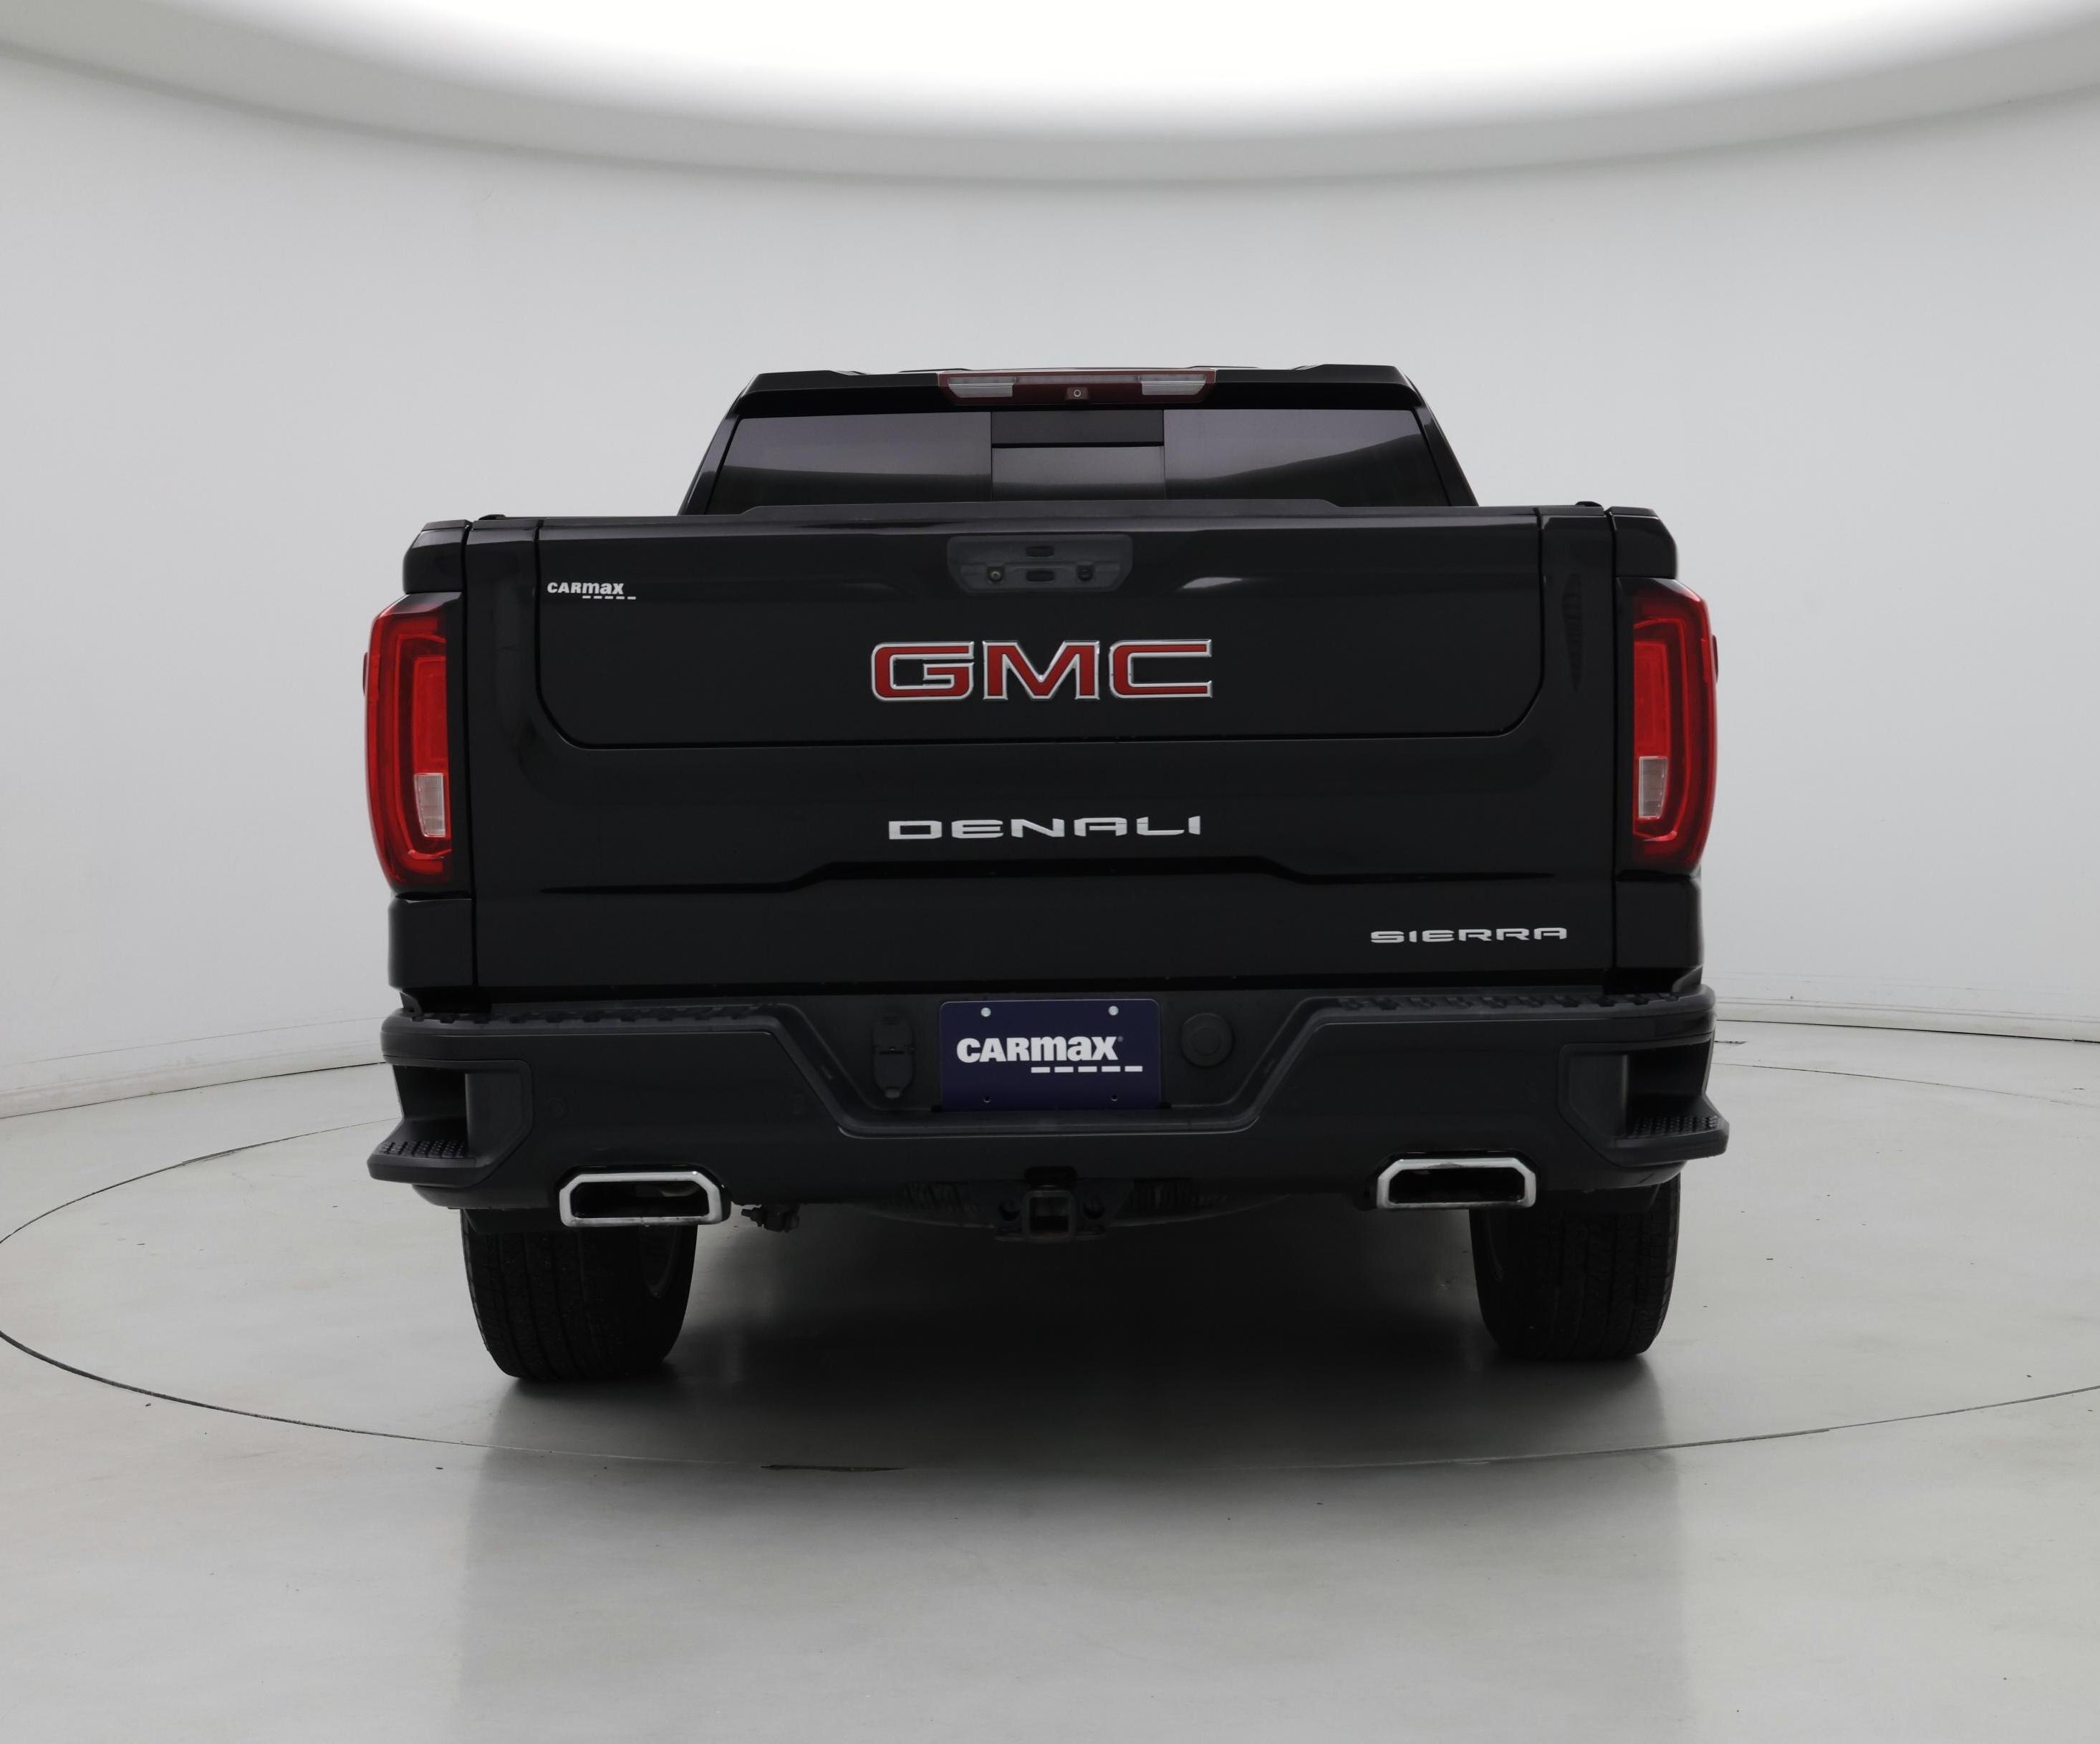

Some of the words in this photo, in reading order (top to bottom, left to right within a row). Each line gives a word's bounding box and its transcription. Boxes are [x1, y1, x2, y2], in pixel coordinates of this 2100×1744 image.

[871, 639, 1213, 701] GMC
[887, 815, 1201, 841] DENALI
[1369, 926, 1568, 944] SIERRA
